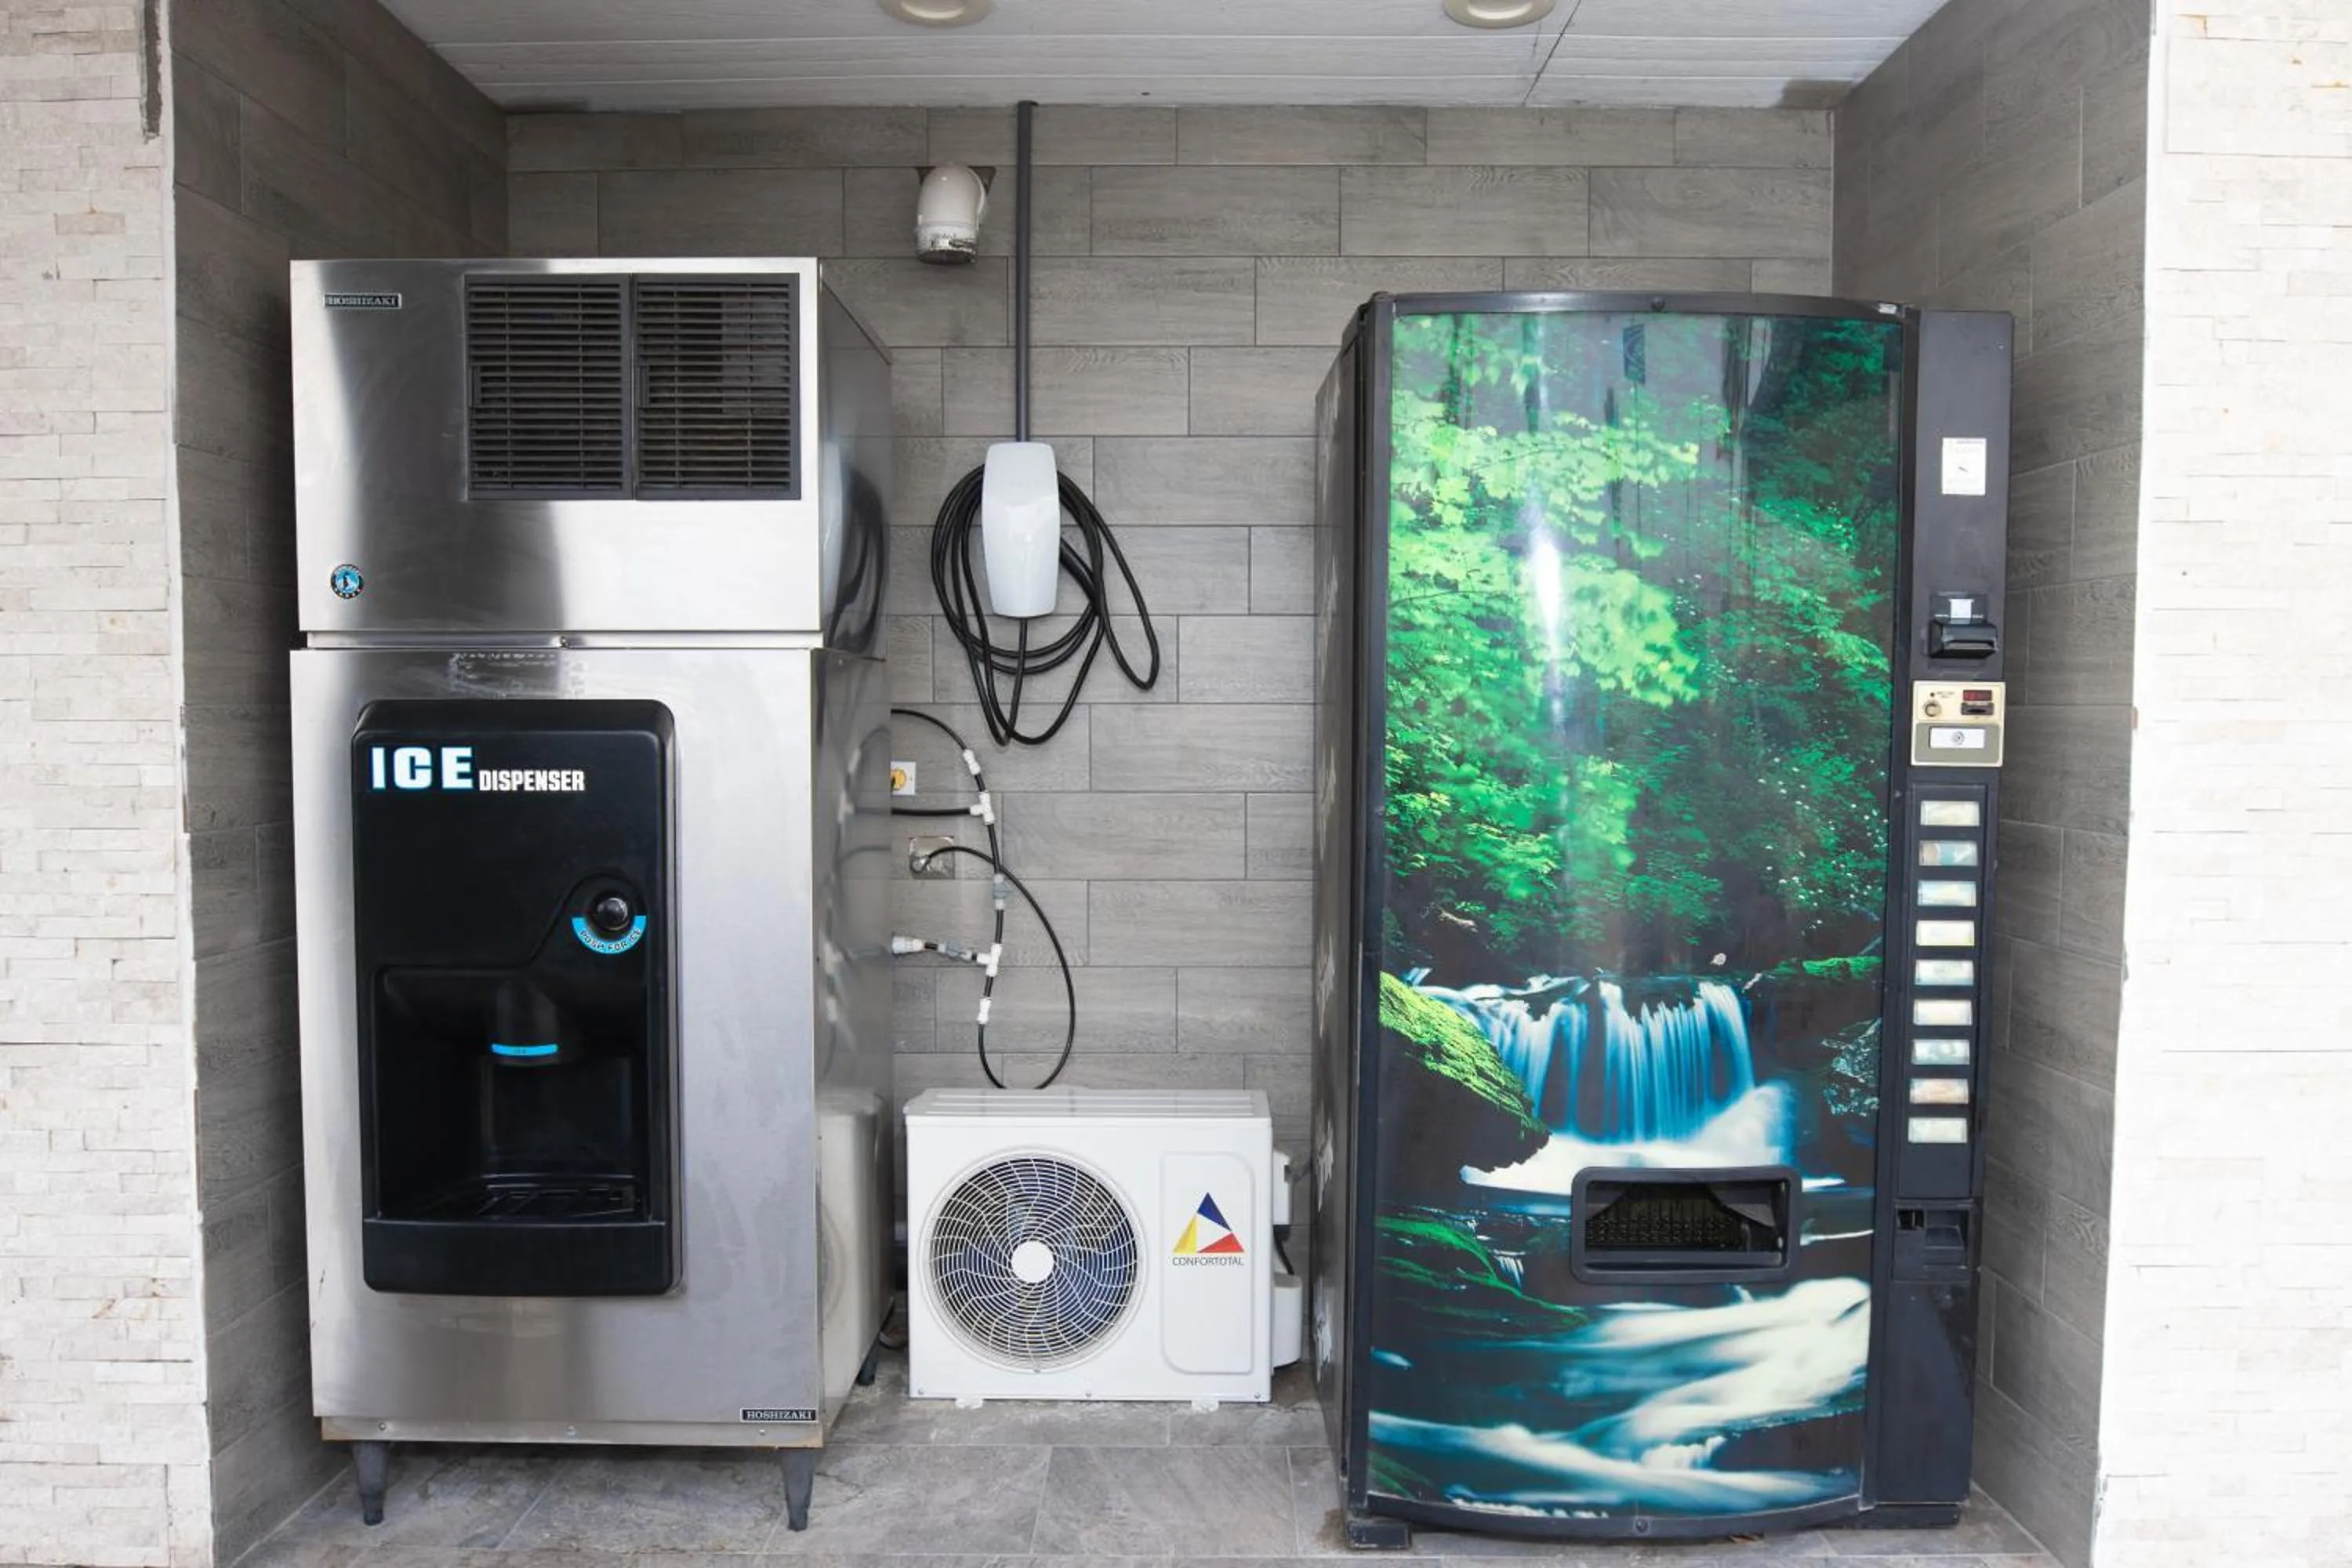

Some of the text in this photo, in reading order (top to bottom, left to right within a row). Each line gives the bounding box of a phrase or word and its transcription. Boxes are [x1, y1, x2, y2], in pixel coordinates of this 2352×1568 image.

[371, 746, 585, 791] ICE DISPENSER
[1172, 1256, 1245, 1266] CONFORTOTAL
[746, 1410, 813, 1420] HOSHIZAKI
